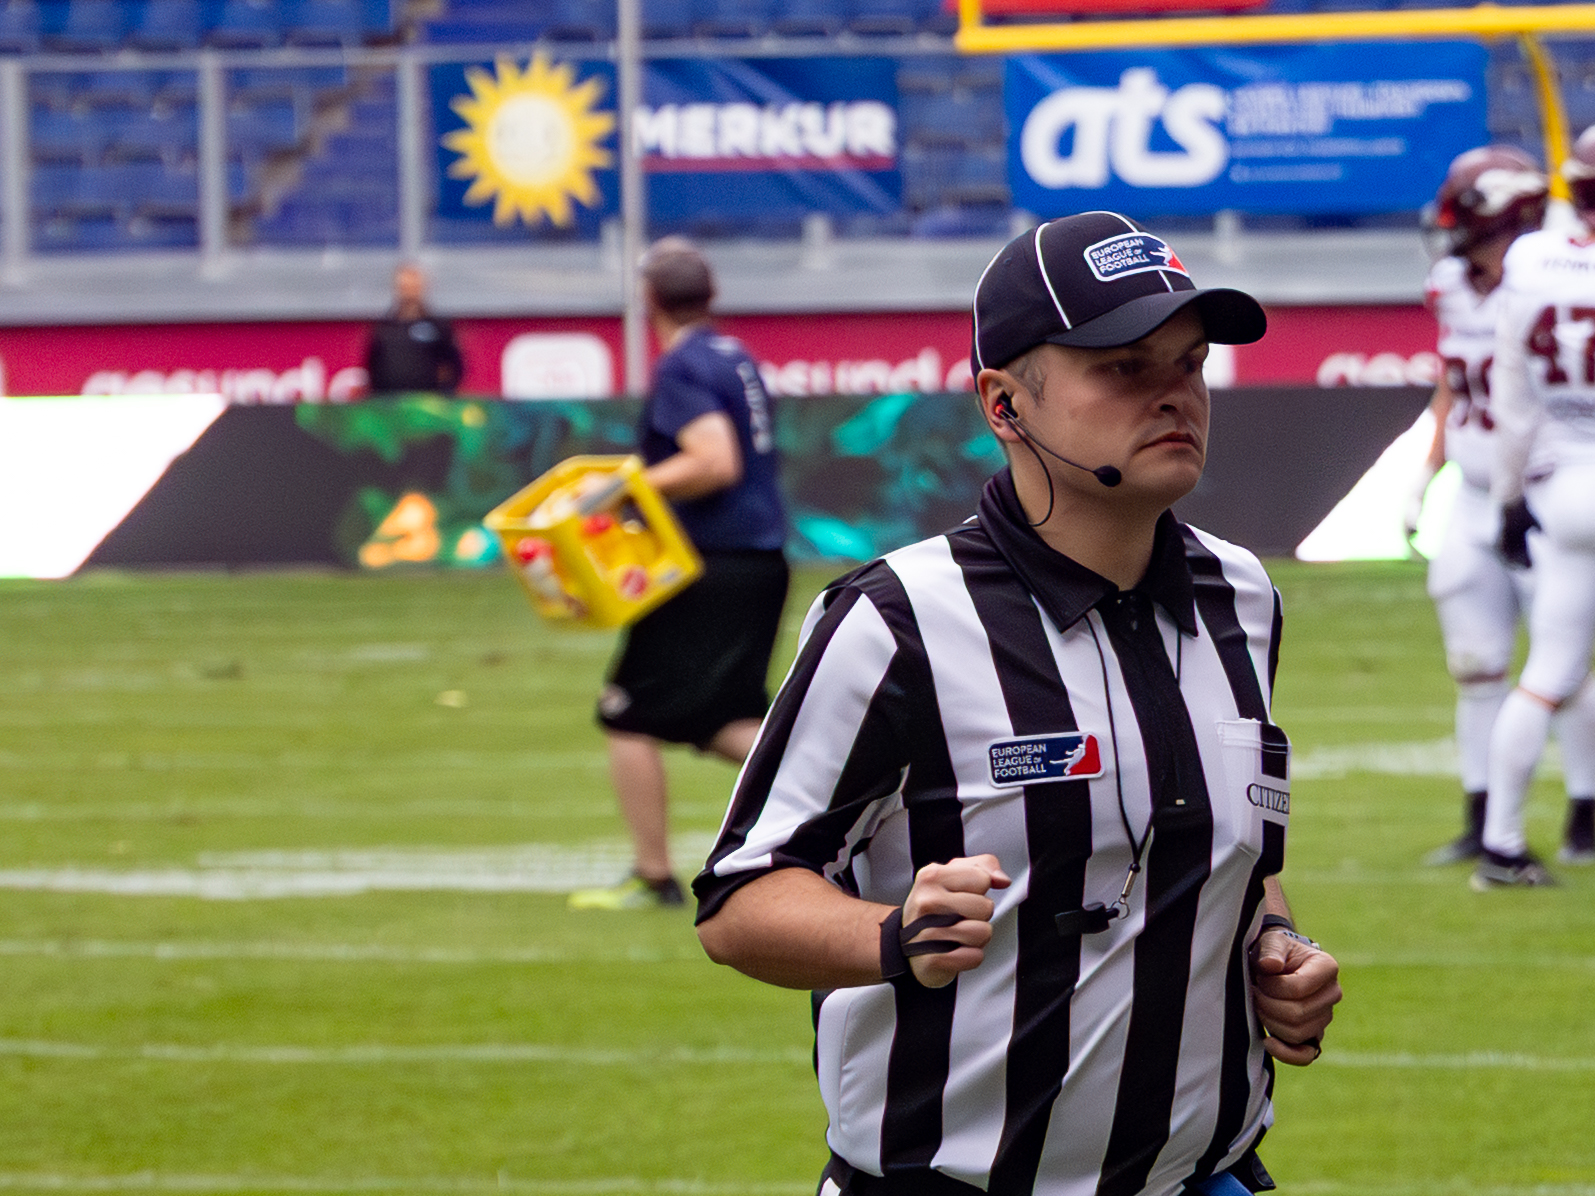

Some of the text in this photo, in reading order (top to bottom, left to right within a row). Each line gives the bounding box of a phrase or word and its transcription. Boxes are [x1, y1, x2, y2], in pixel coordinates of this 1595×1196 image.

[633, 100, 896, 159] MERKUR
[1020, 67, 1230, 189] ats
[1090, 238, 1144, 260] EUROPEAN
[1095, 248, 1133, 267] LEAGUE
[1099, 254, 1151, 274] FOOTBALL
[992, 744, 1047, 758] EUROPEAN
[993, 755, 1032, 768] LEAGUE
[995, 764, 1047, 778] FOOTBALL
[1247, 783, 1290, 815] CITIZE
